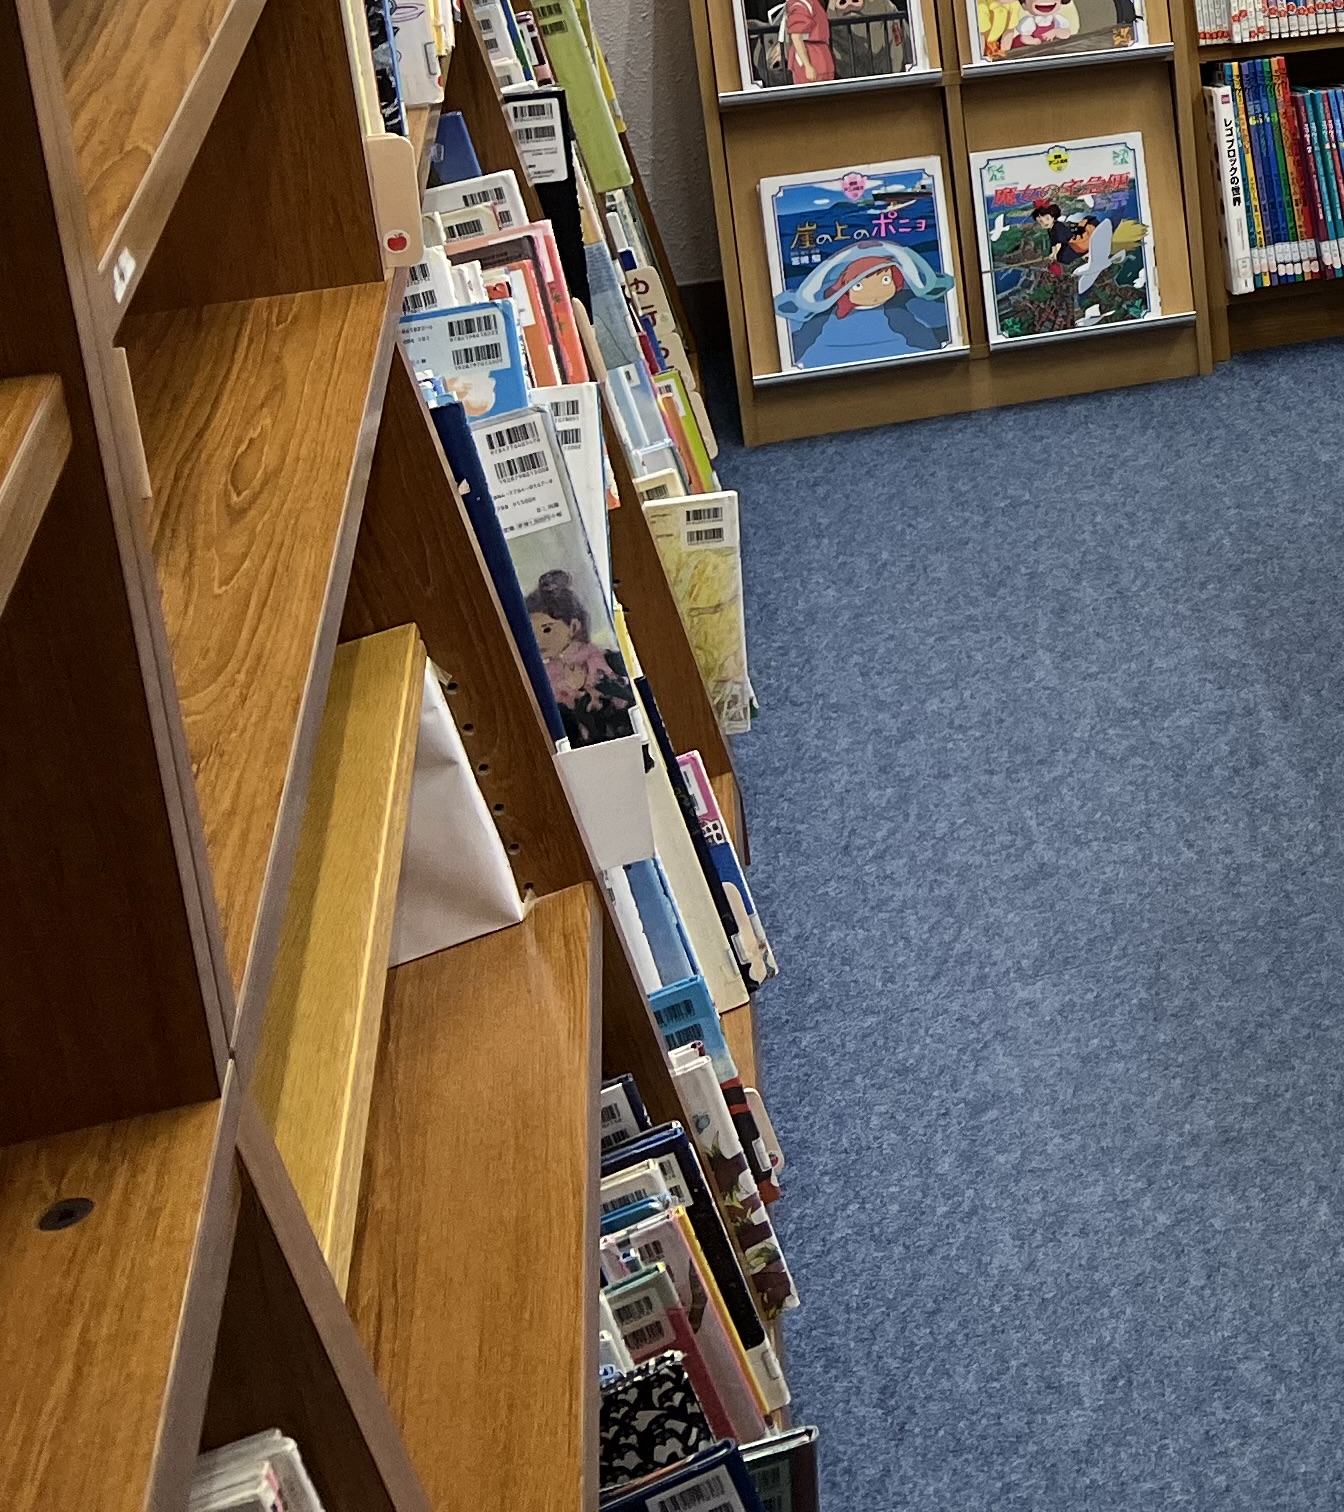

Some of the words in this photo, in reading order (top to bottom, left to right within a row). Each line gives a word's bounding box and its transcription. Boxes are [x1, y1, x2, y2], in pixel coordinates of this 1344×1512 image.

[1223, 118, 1242, 207] レゴブロックの世界
[992, 172, 1131, 207] 魔女の宅急便
[790, 211, 926, 250] 崖の上のポニョ
